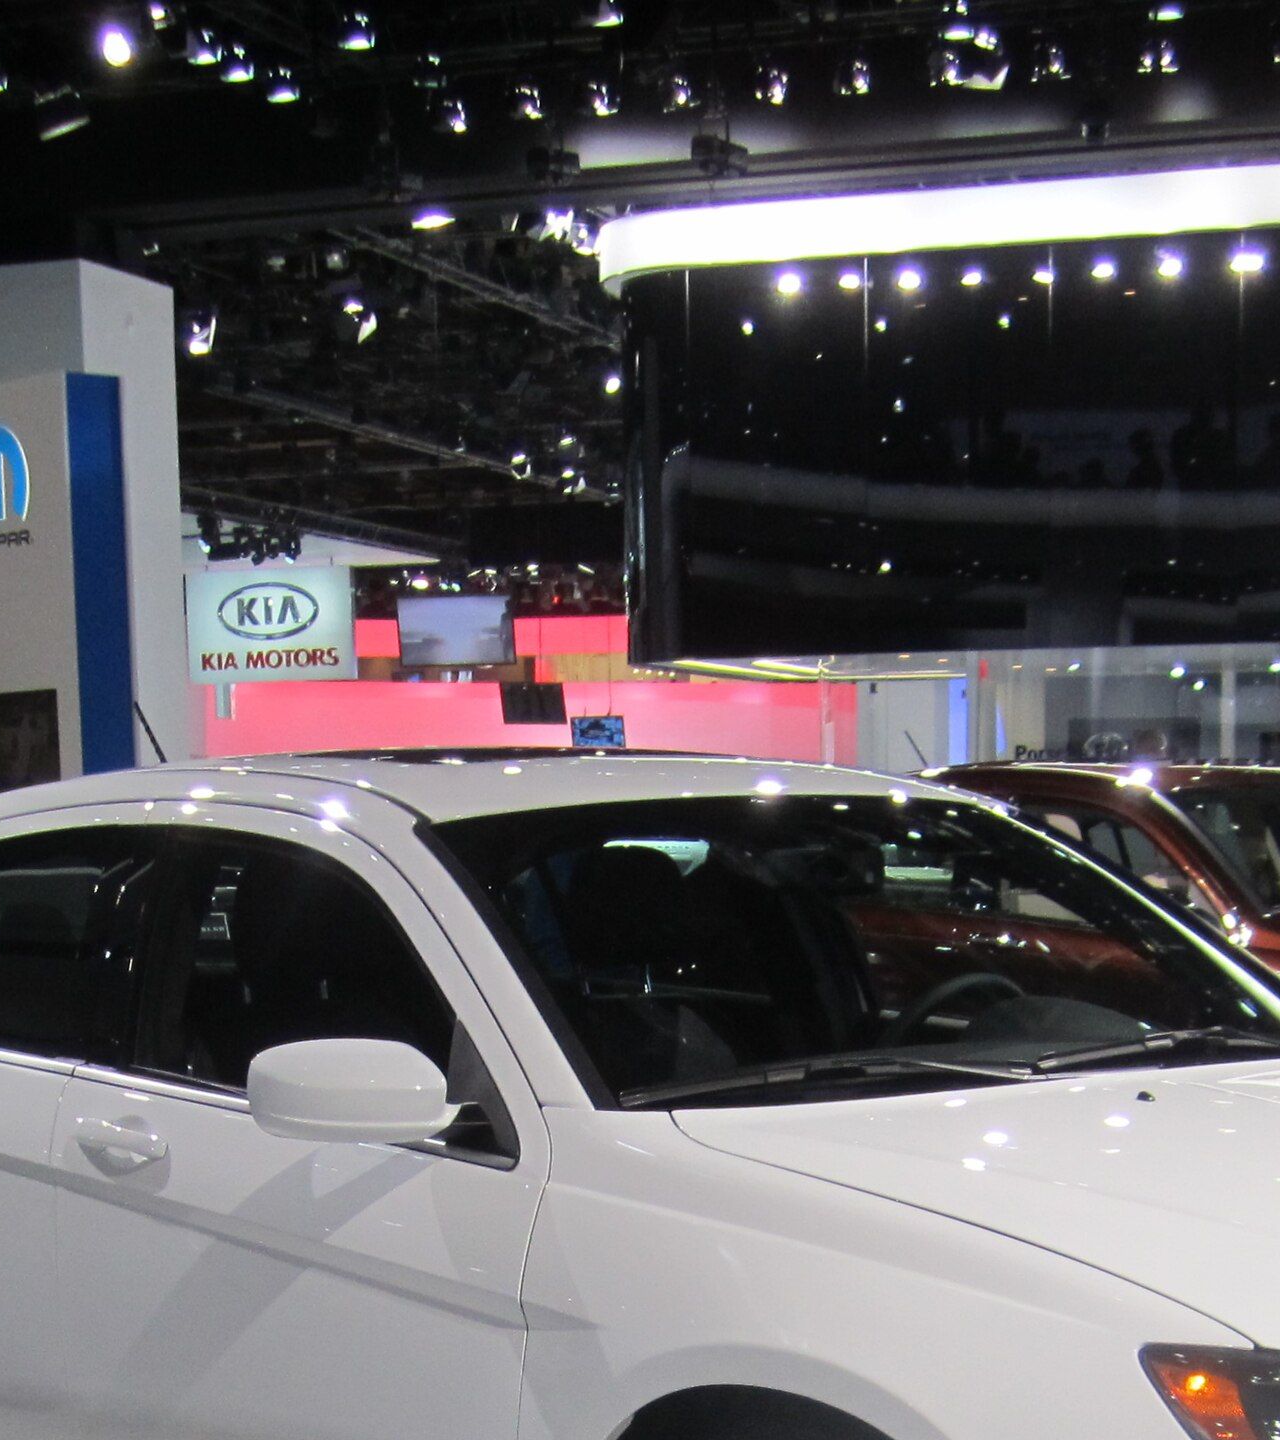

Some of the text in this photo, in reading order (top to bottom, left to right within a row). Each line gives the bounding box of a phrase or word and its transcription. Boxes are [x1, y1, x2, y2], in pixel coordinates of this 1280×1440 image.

[236, 595, 302, 626] KIA
[201, 647, 340, 671] KIA MOTORS
